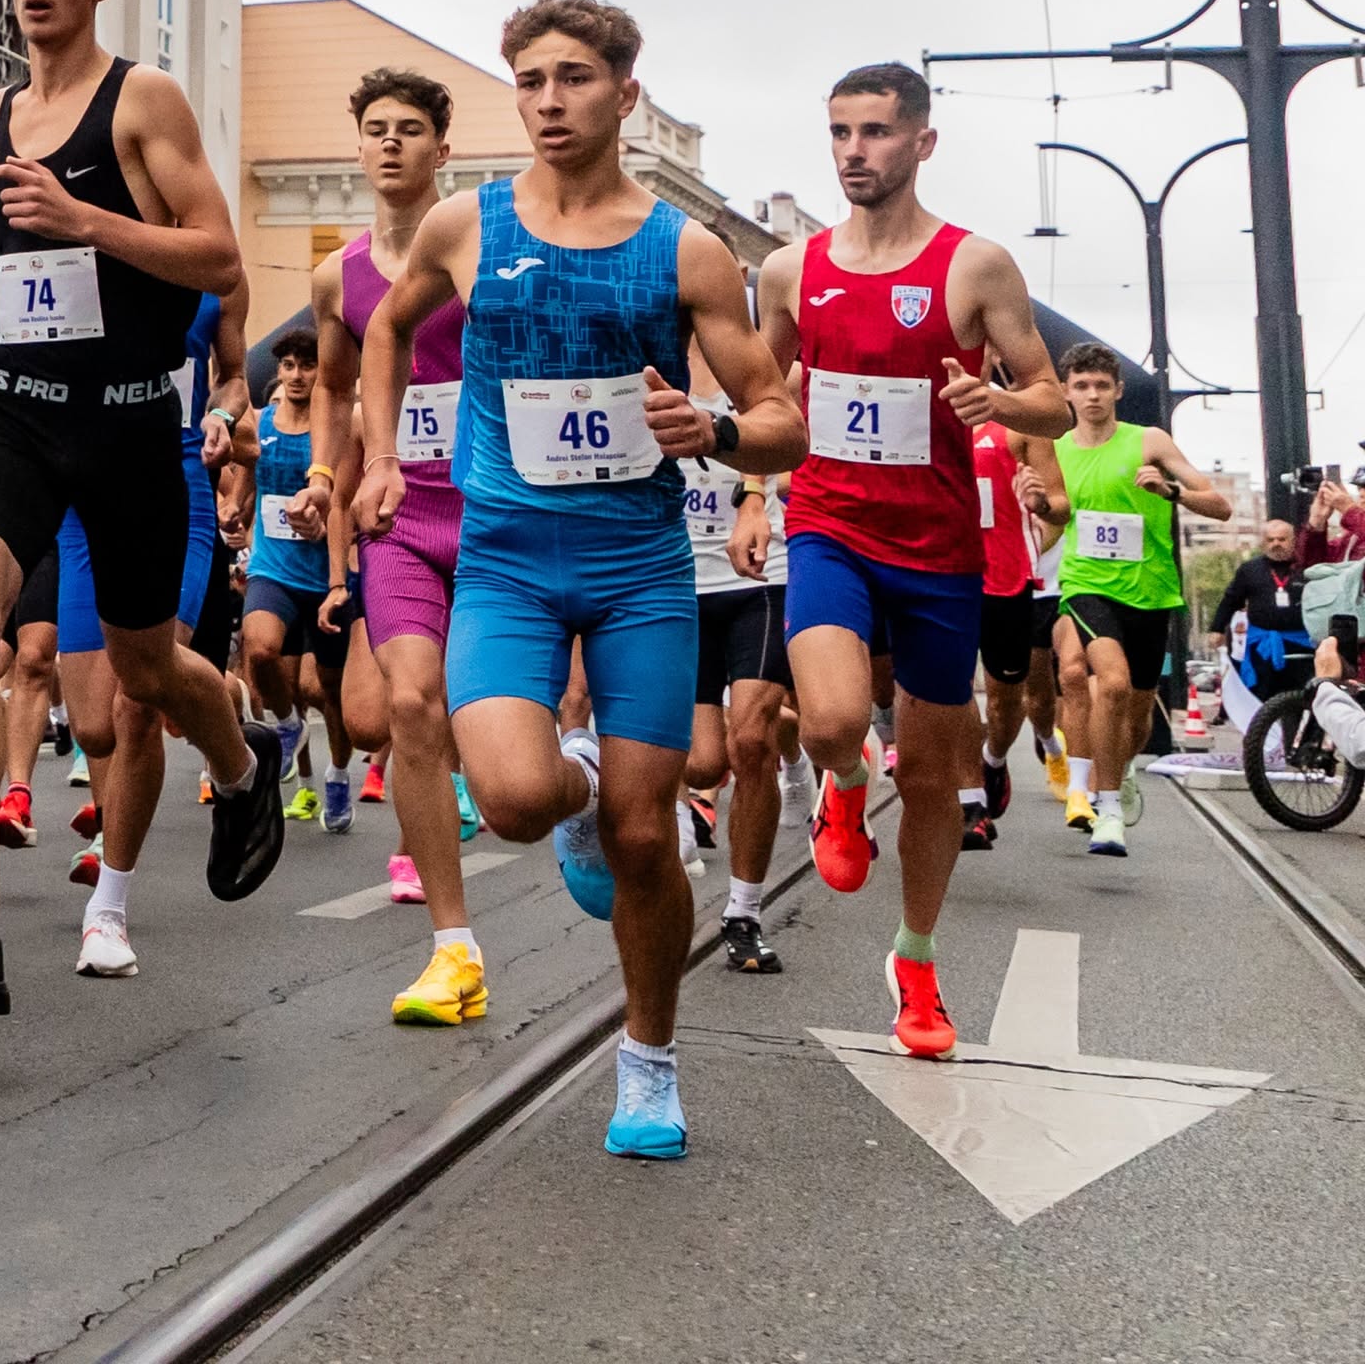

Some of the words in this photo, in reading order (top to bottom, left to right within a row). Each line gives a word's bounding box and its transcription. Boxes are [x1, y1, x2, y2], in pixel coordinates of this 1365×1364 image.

[22, 278, 56, 312] 74
[14, 374, 69, 403] PRO
[405, 407, 439, 436] 75
[559, 410, 610, 449] 46
[847, 400, 880, 435] 21
[688, 488, 718, 514] 84
[1096, 525, 1118, 544] 83
